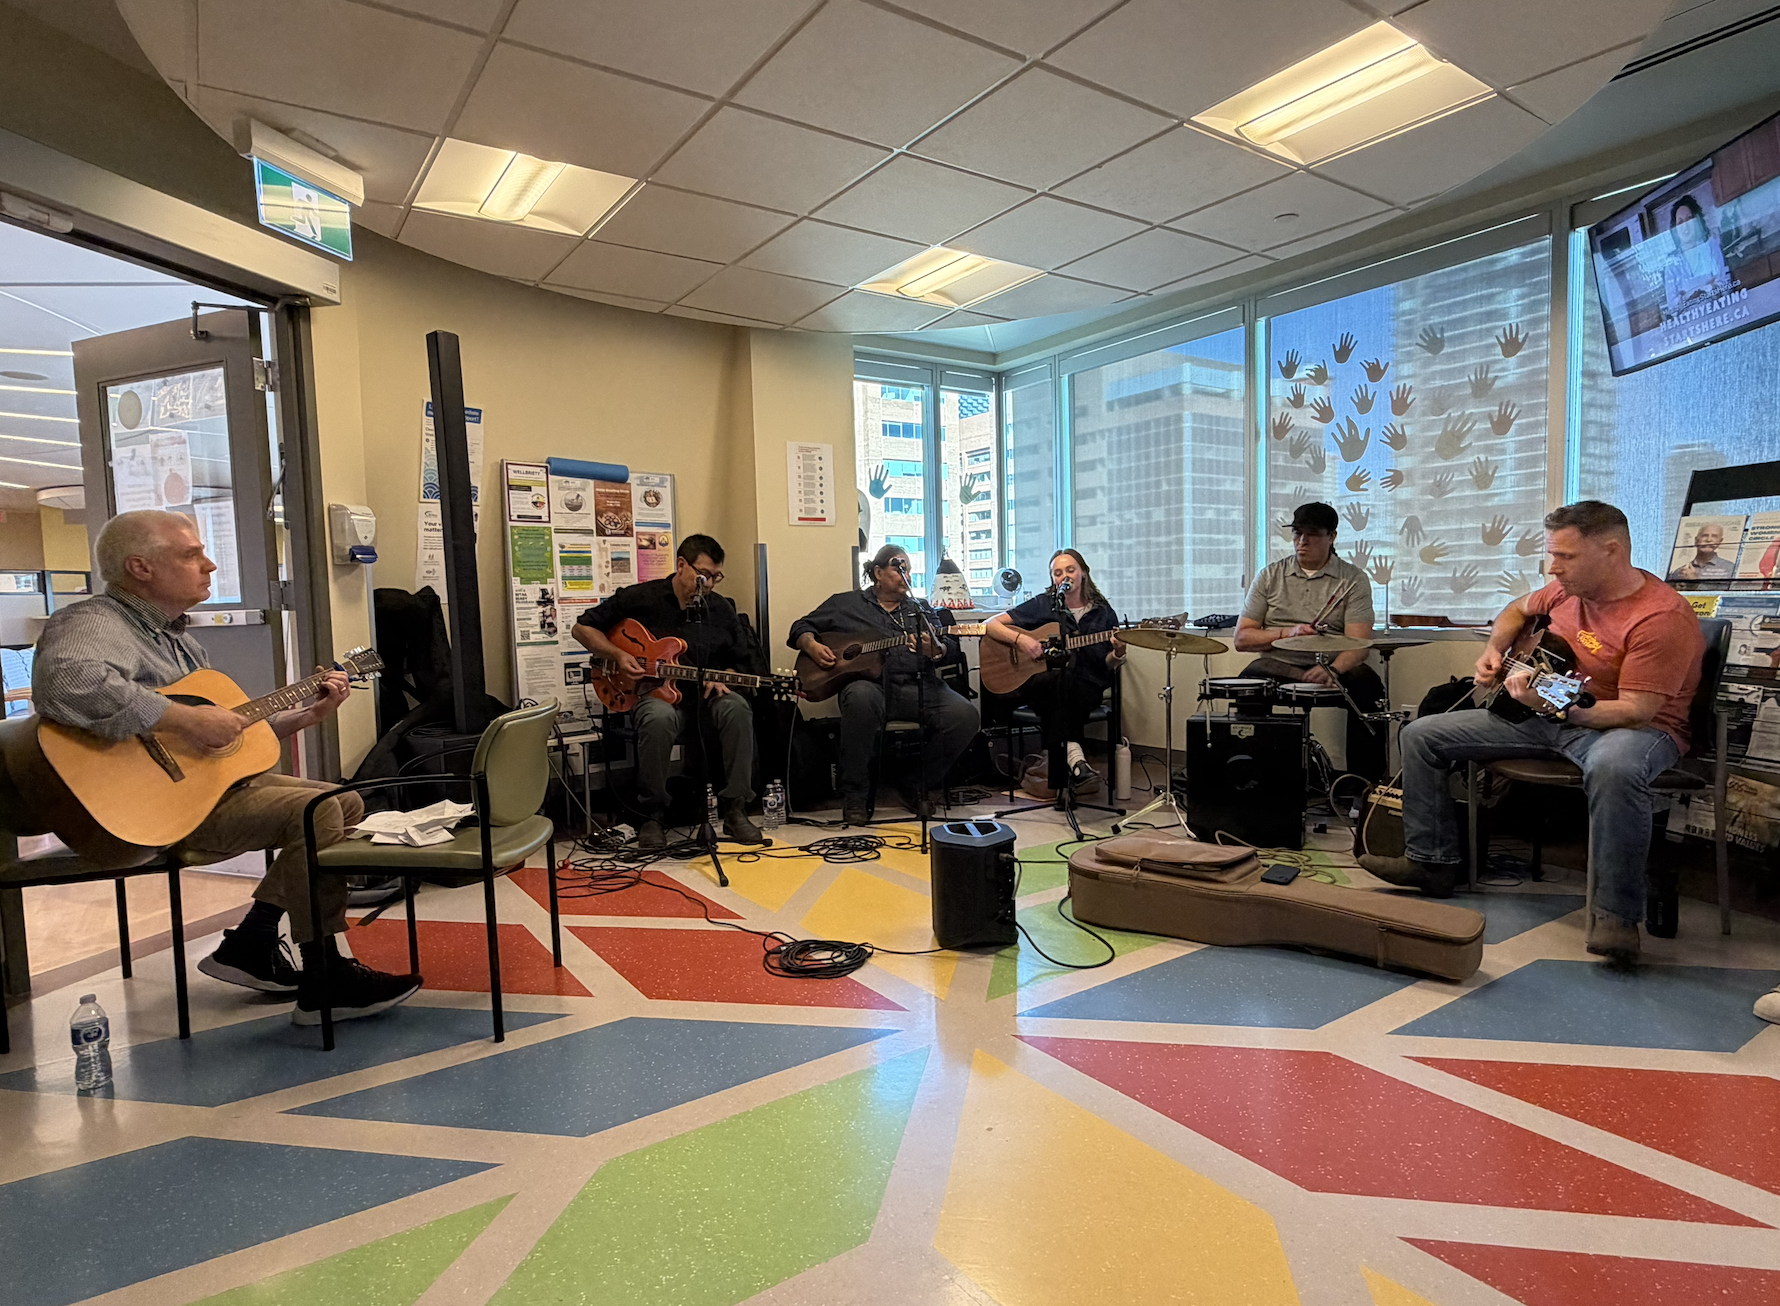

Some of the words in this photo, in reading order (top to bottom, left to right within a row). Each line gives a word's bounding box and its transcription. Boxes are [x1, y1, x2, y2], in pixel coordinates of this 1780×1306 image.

[1659, 287, 1749, 333] HEALTHYEATING
[1663, 305, 1750, 347] STARTSHERE.CA
[512, 469, 541, 477] WELLBRIETY
